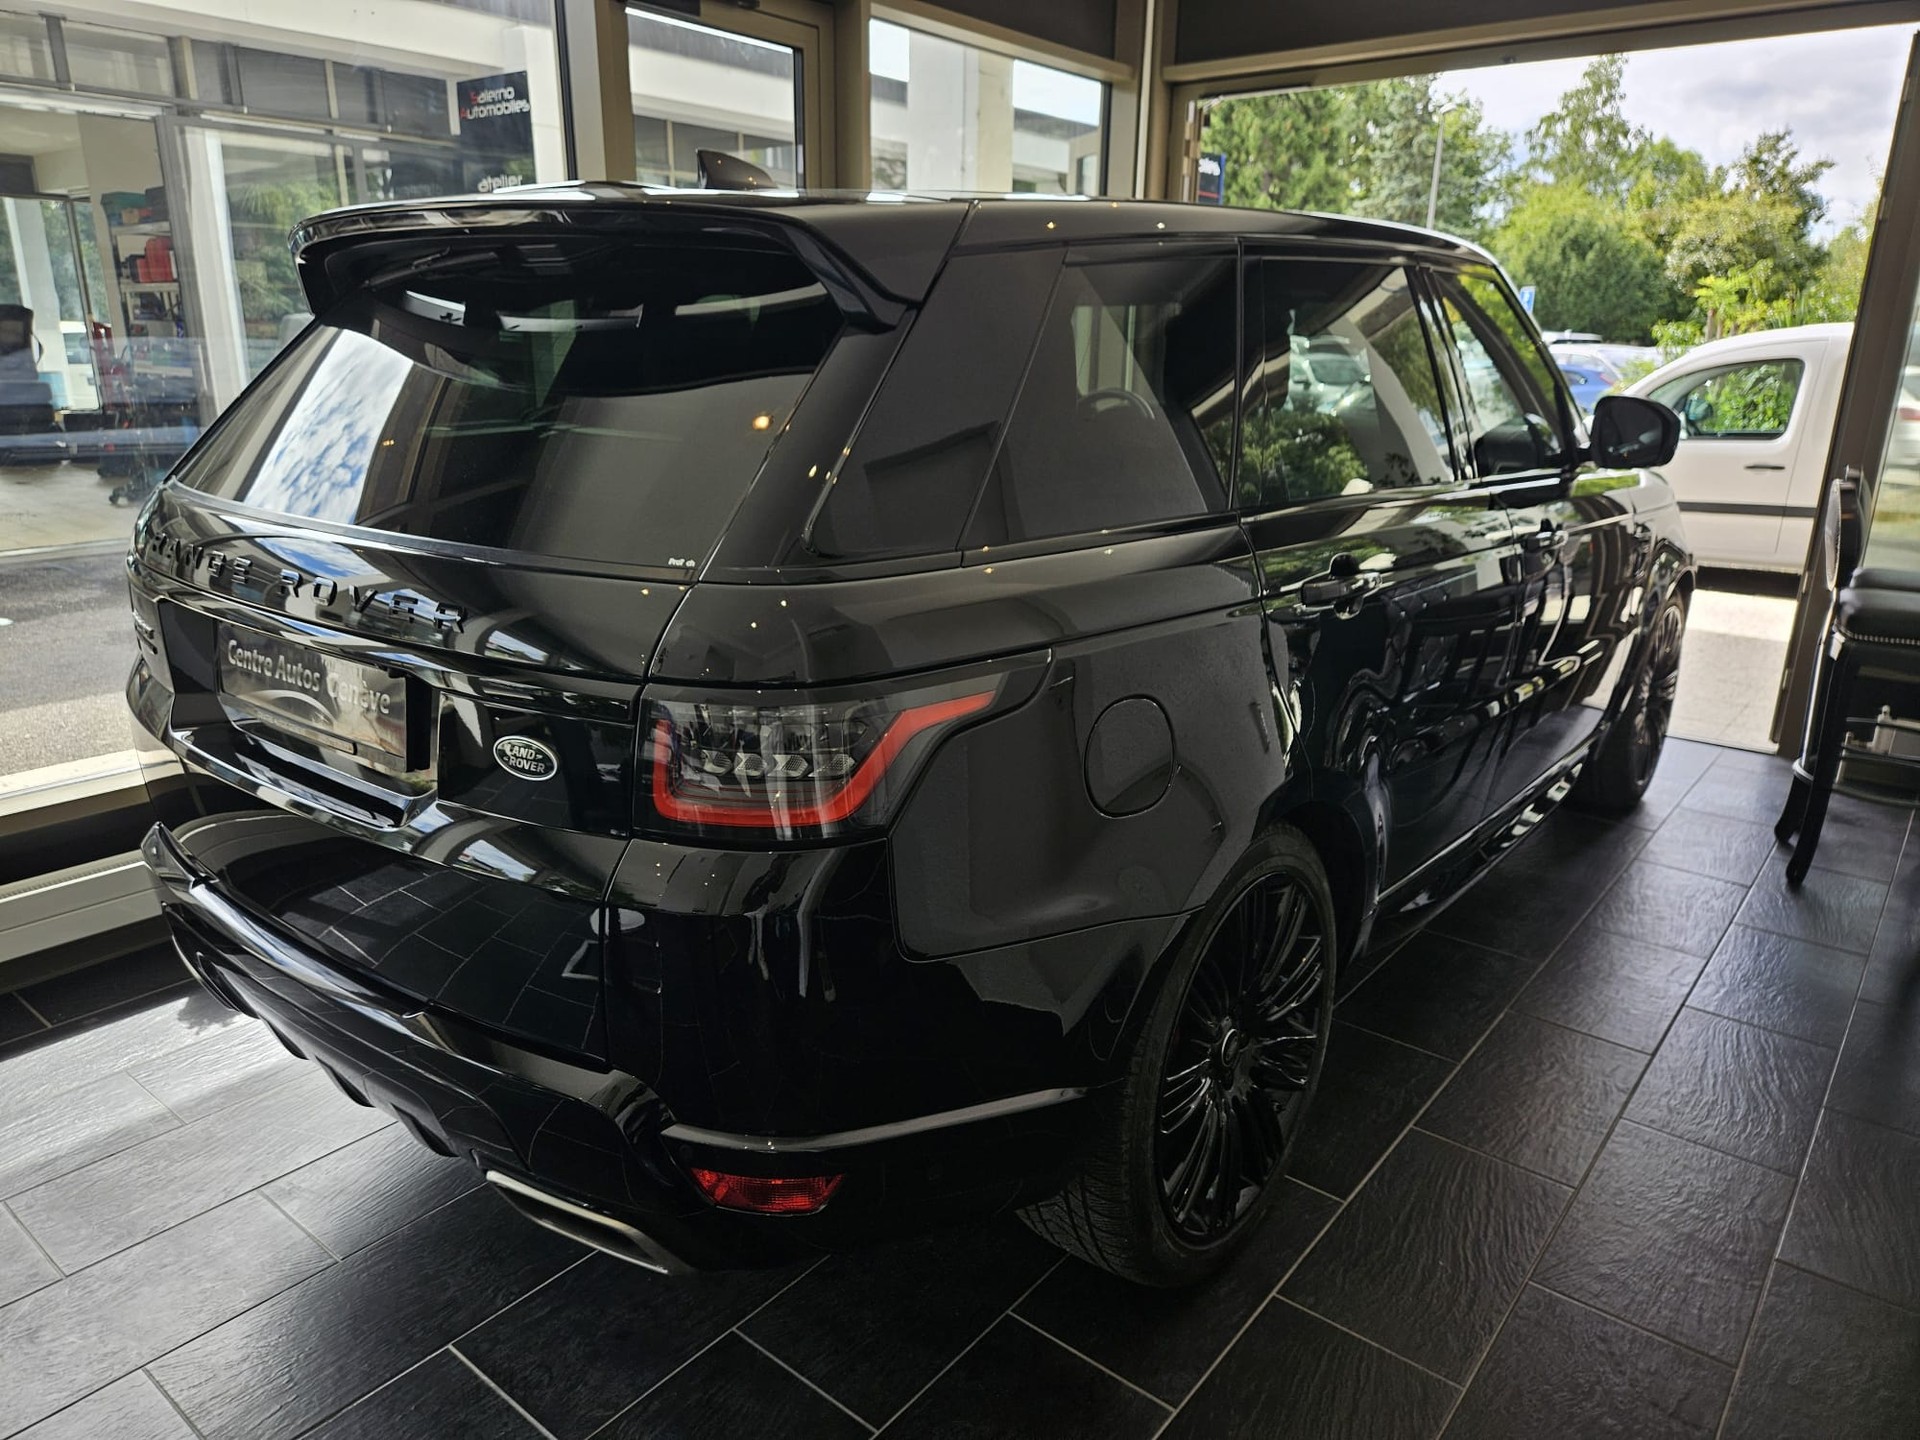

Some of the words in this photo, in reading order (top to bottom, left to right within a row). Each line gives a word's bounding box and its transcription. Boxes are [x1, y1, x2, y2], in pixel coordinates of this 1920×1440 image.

[460, 98, 531, 120] Automobiles
[150, 533, 252, 585] RANGE
[280, 568, 468, 634] ROVER
[227, 639, 273, 677] Centre
[276, 654, 321, 692] Autos
[505, 743, 535, 760] LAND
[509, 756, 545, 773] ROVER
